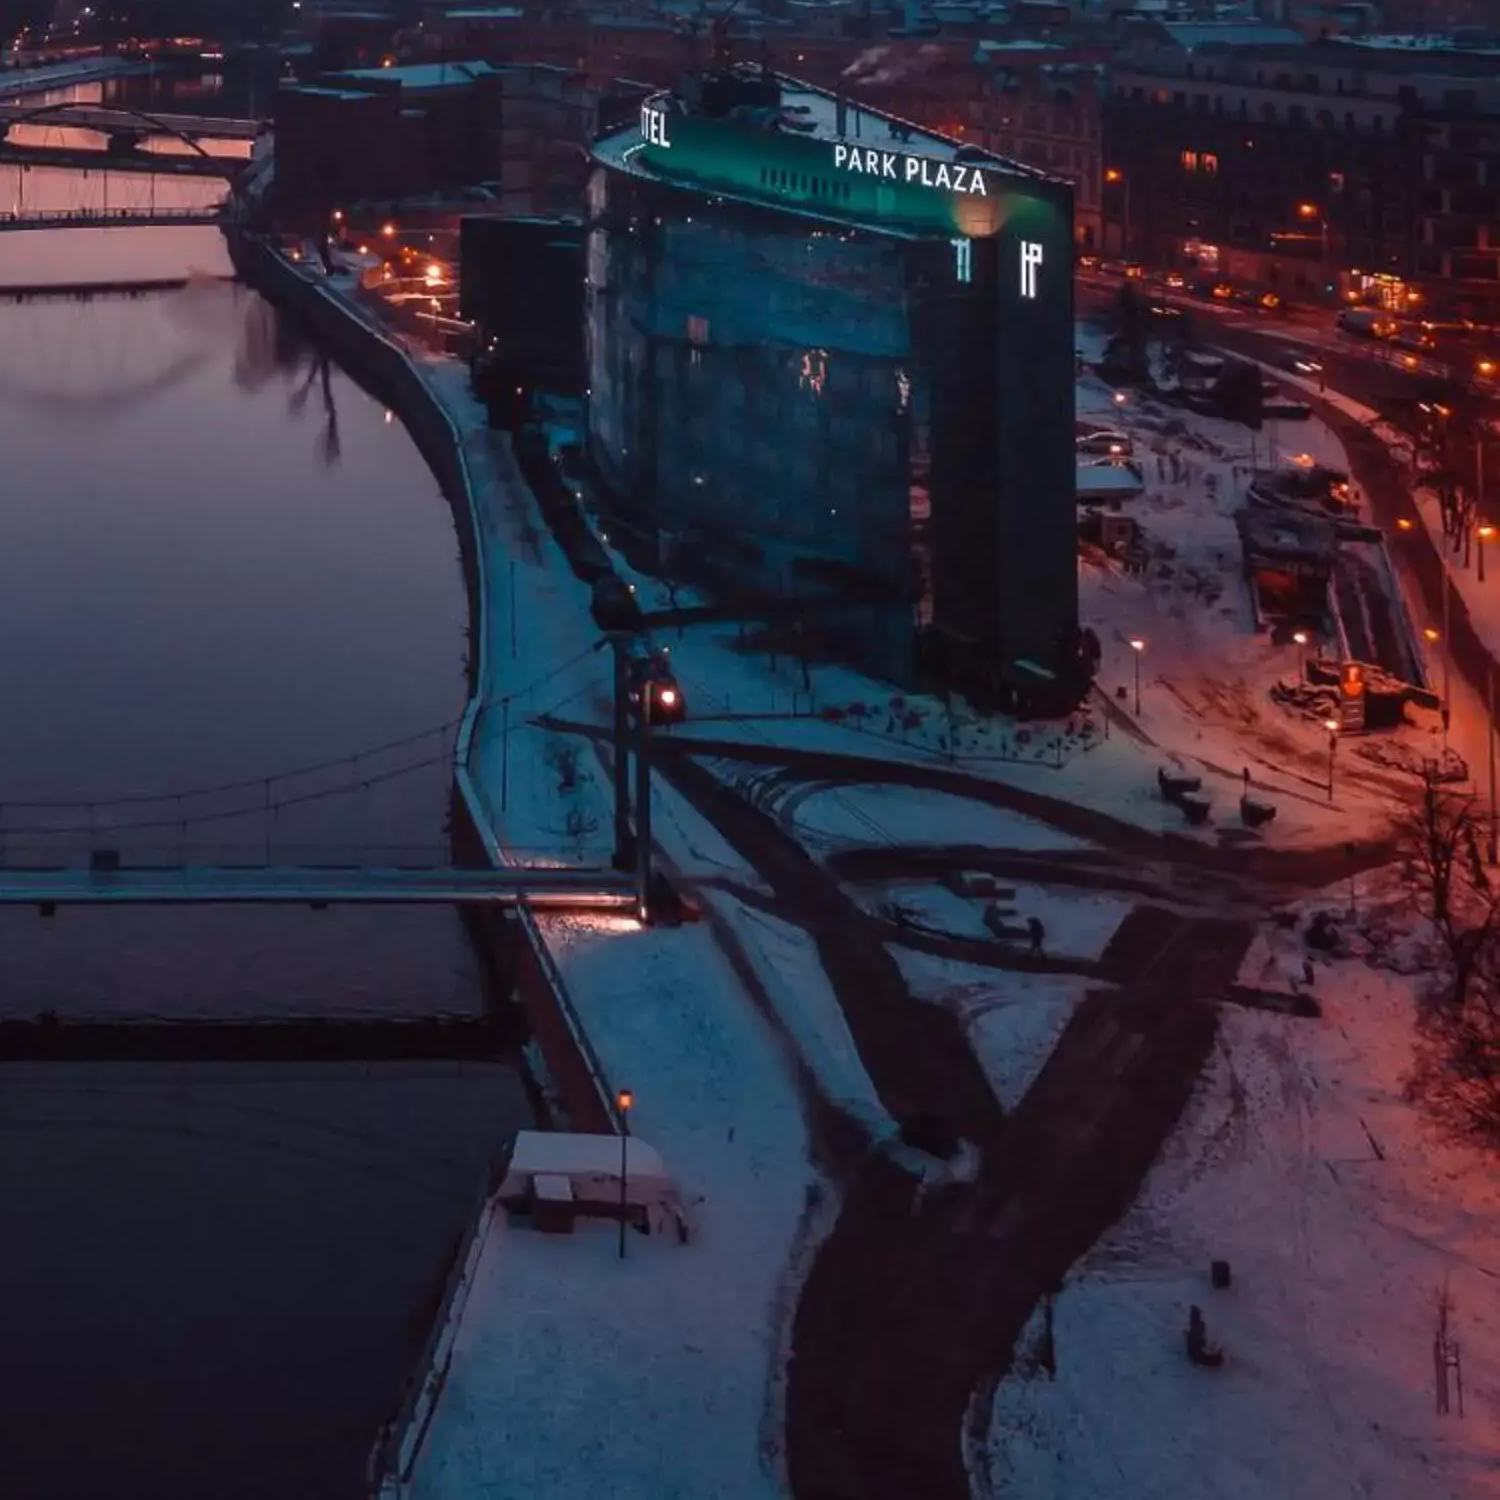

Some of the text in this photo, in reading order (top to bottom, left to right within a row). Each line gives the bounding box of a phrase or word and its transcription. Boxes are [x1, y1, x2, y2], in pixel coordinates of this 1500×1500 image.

[641, 104, 671, 148] TEL
[834, 145, 987, 196] PARK PLAZA
